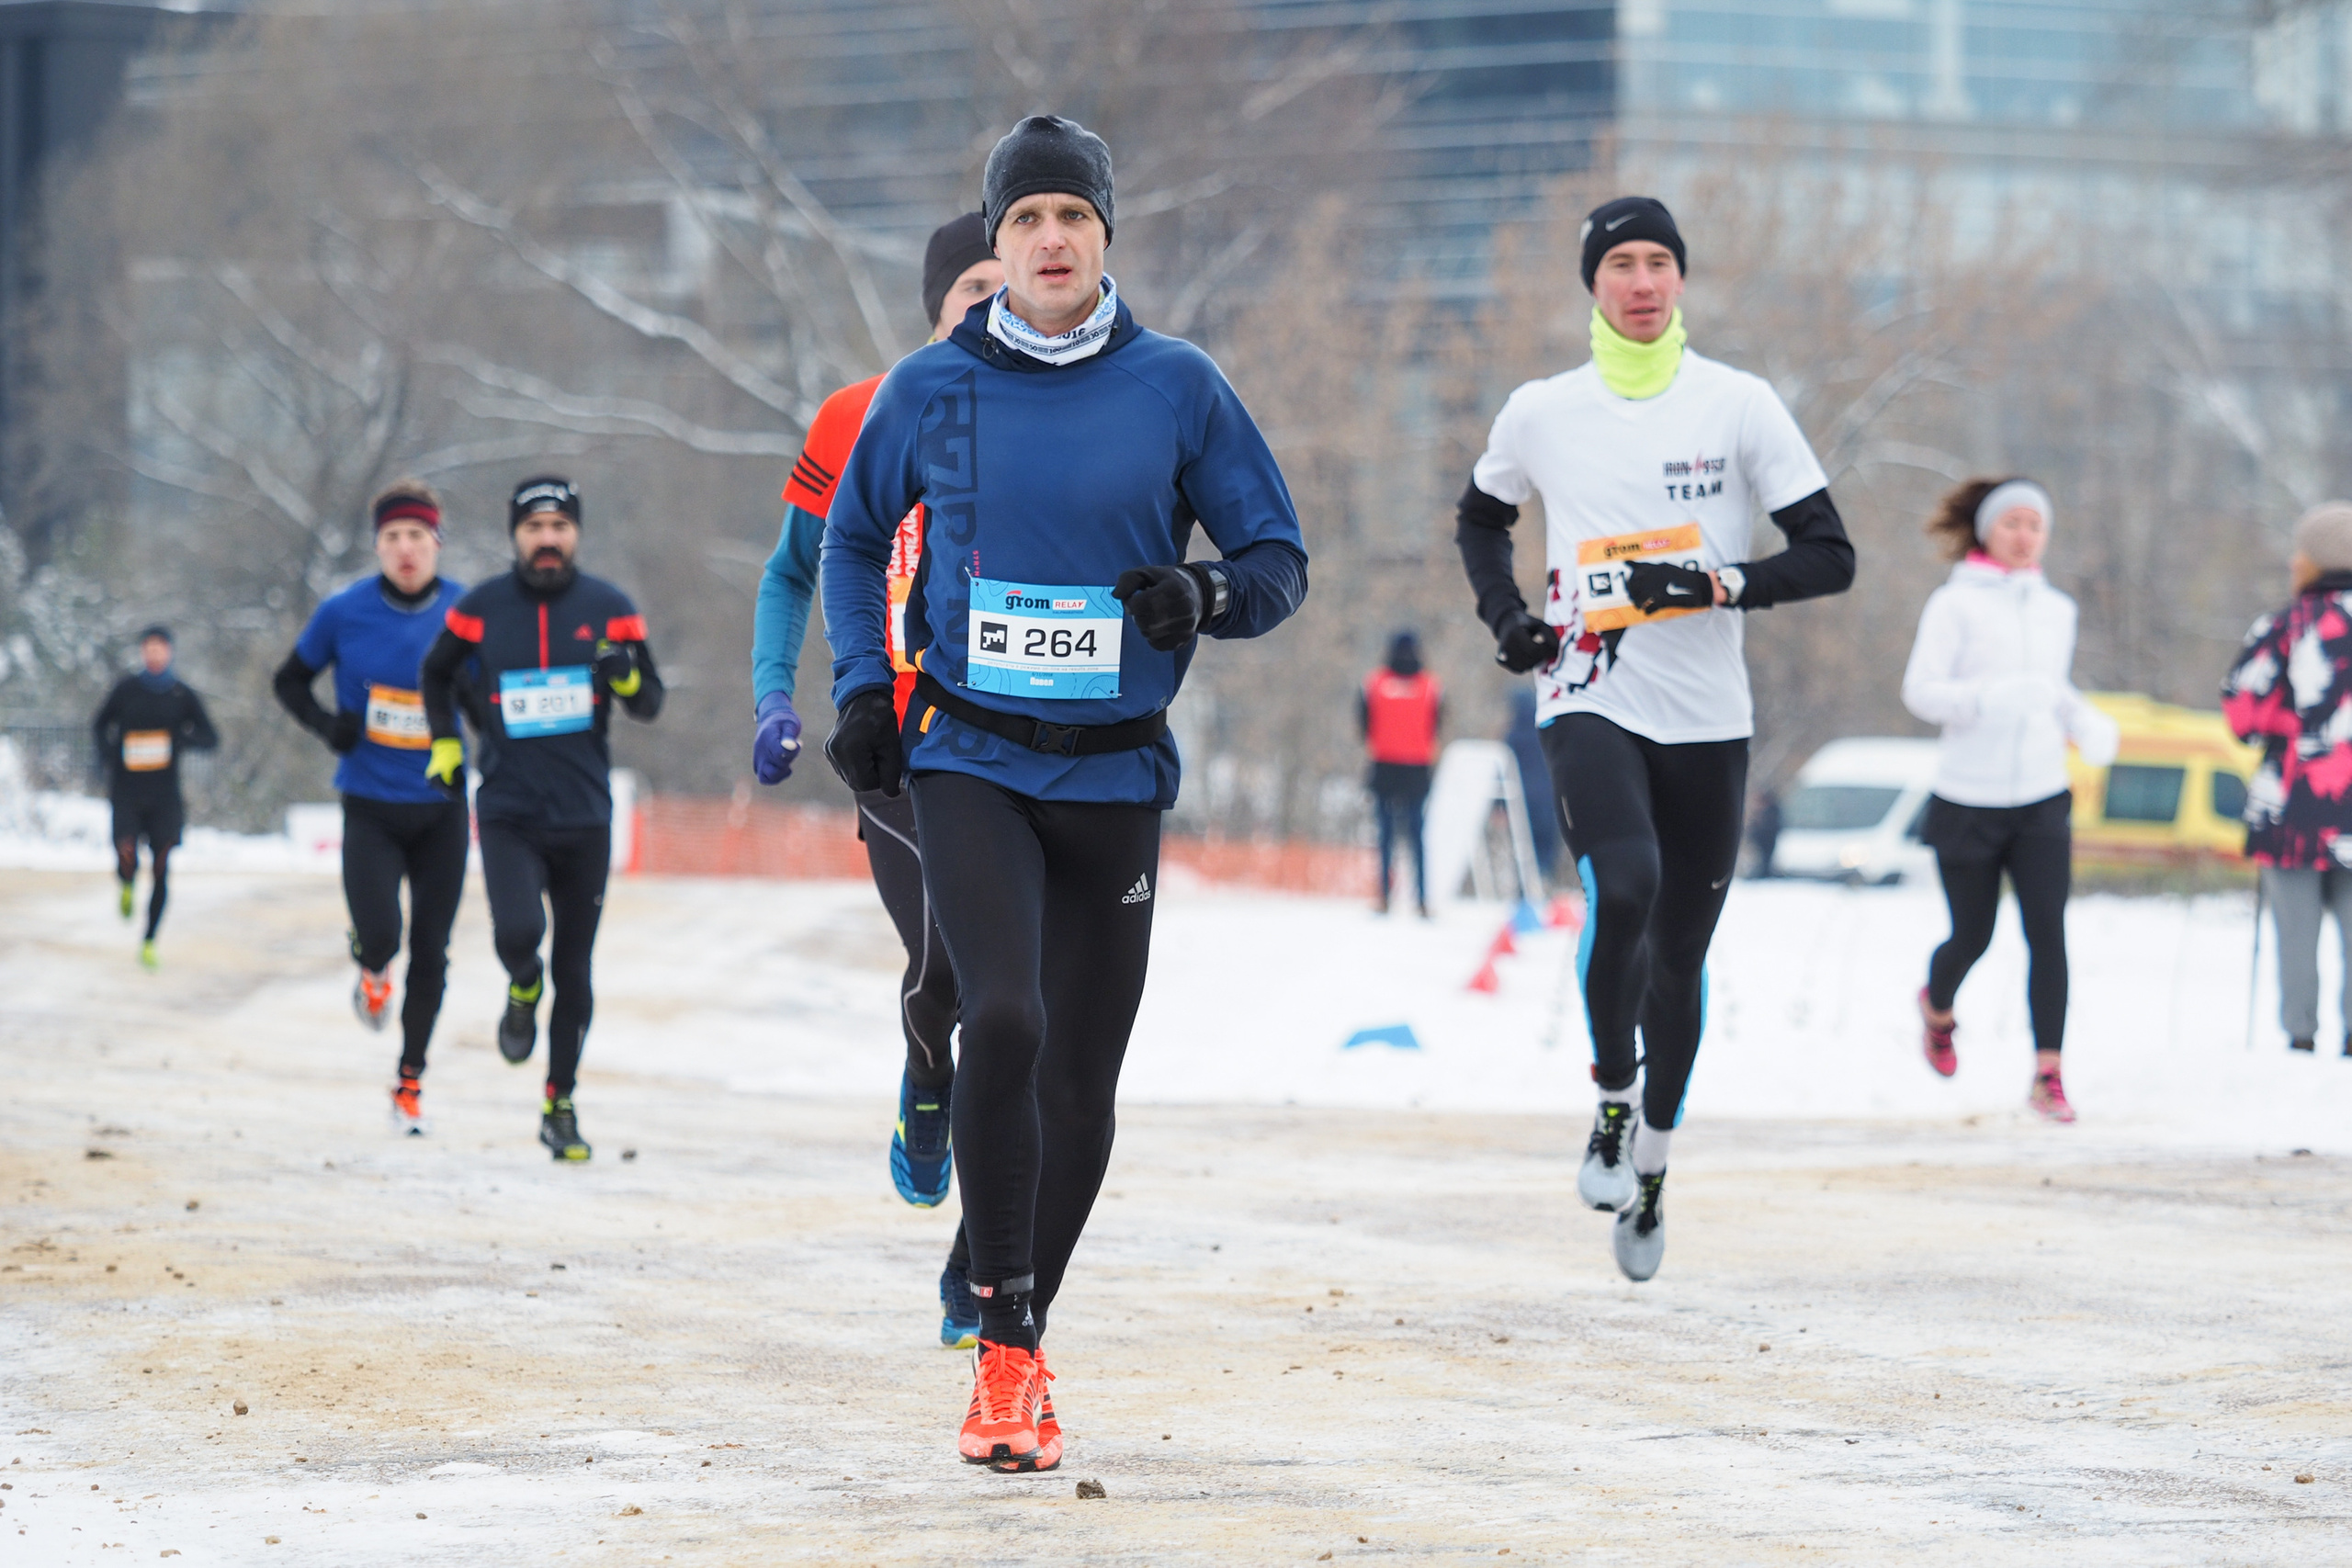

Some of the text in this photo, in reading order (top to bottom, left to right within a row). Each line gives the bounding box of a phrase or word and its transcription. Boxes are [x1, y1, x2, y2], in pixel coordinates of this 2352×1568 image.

[1072, 339, 1080, 347] 10
[1090, 331, 1100, 340] 30
[1665, 480, 1723, 501] TEAM
[1604, 542, 1642, 559] grom
[1005, 594, 1084, 610] grom RELAY
[1024, 628, 1097, 658] 264
[1121, 890, 1151, 904] adidas
